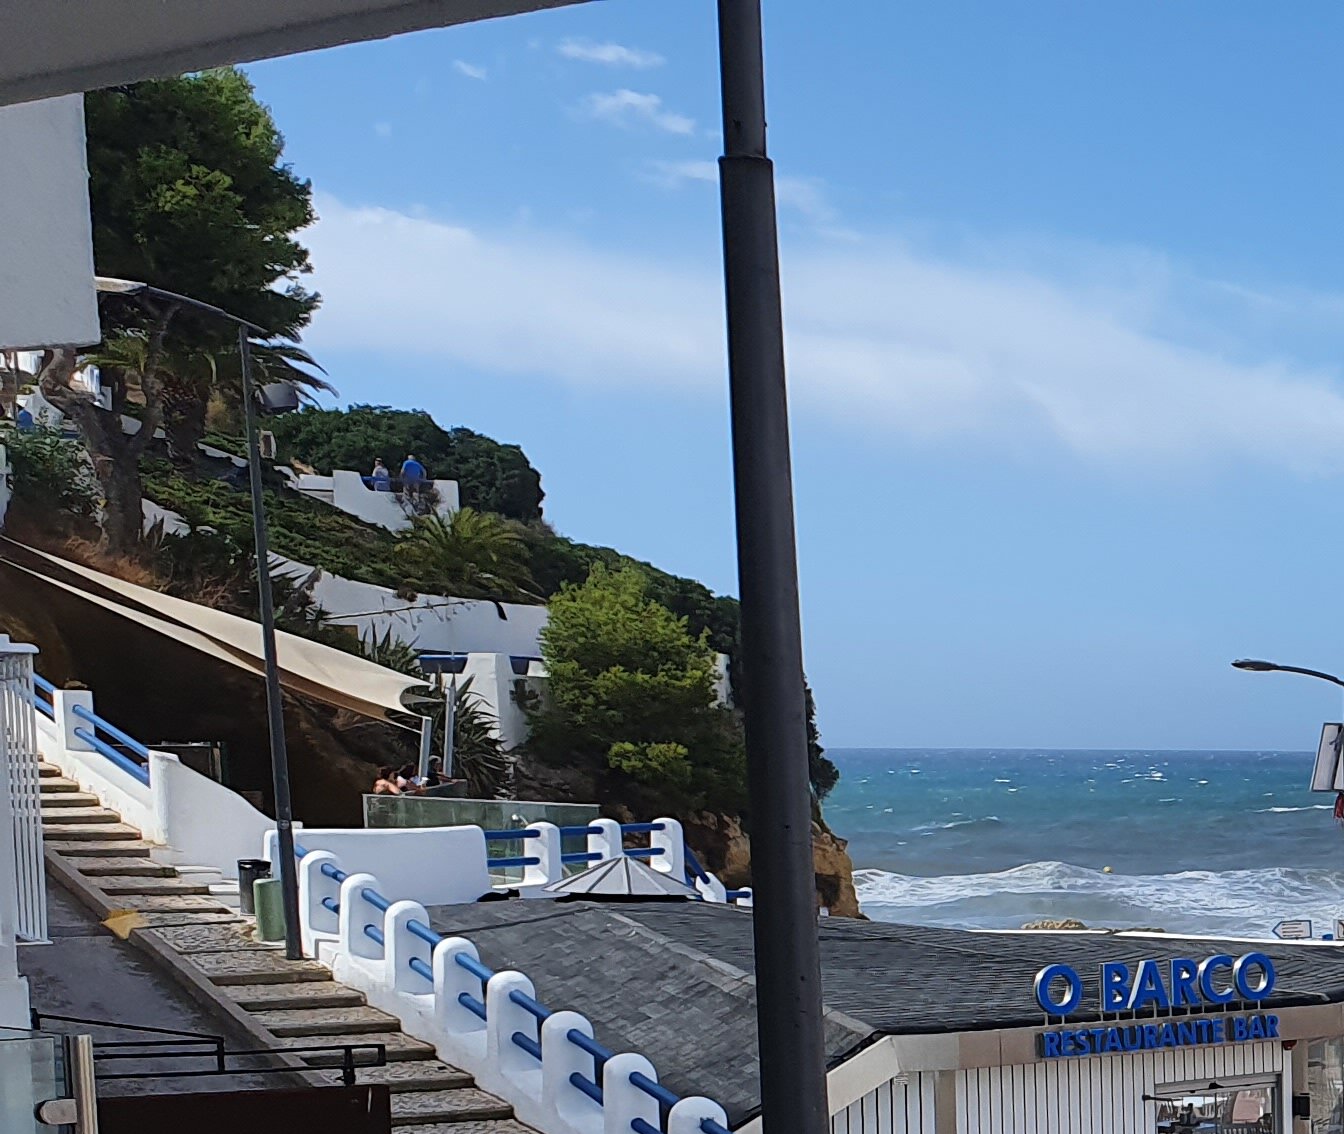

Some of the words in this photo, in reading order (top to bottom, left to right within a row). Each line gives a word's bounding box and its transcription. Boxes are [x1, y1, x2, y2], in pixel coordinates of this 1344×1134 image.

[1034, 963, 1083, 1016] O
[1101, 951, 1276, 1012] BARCO
[1041, 1017, 1226, 1059] RESTAURANTE
[1233, 1014, 1280, 1042] BAR
